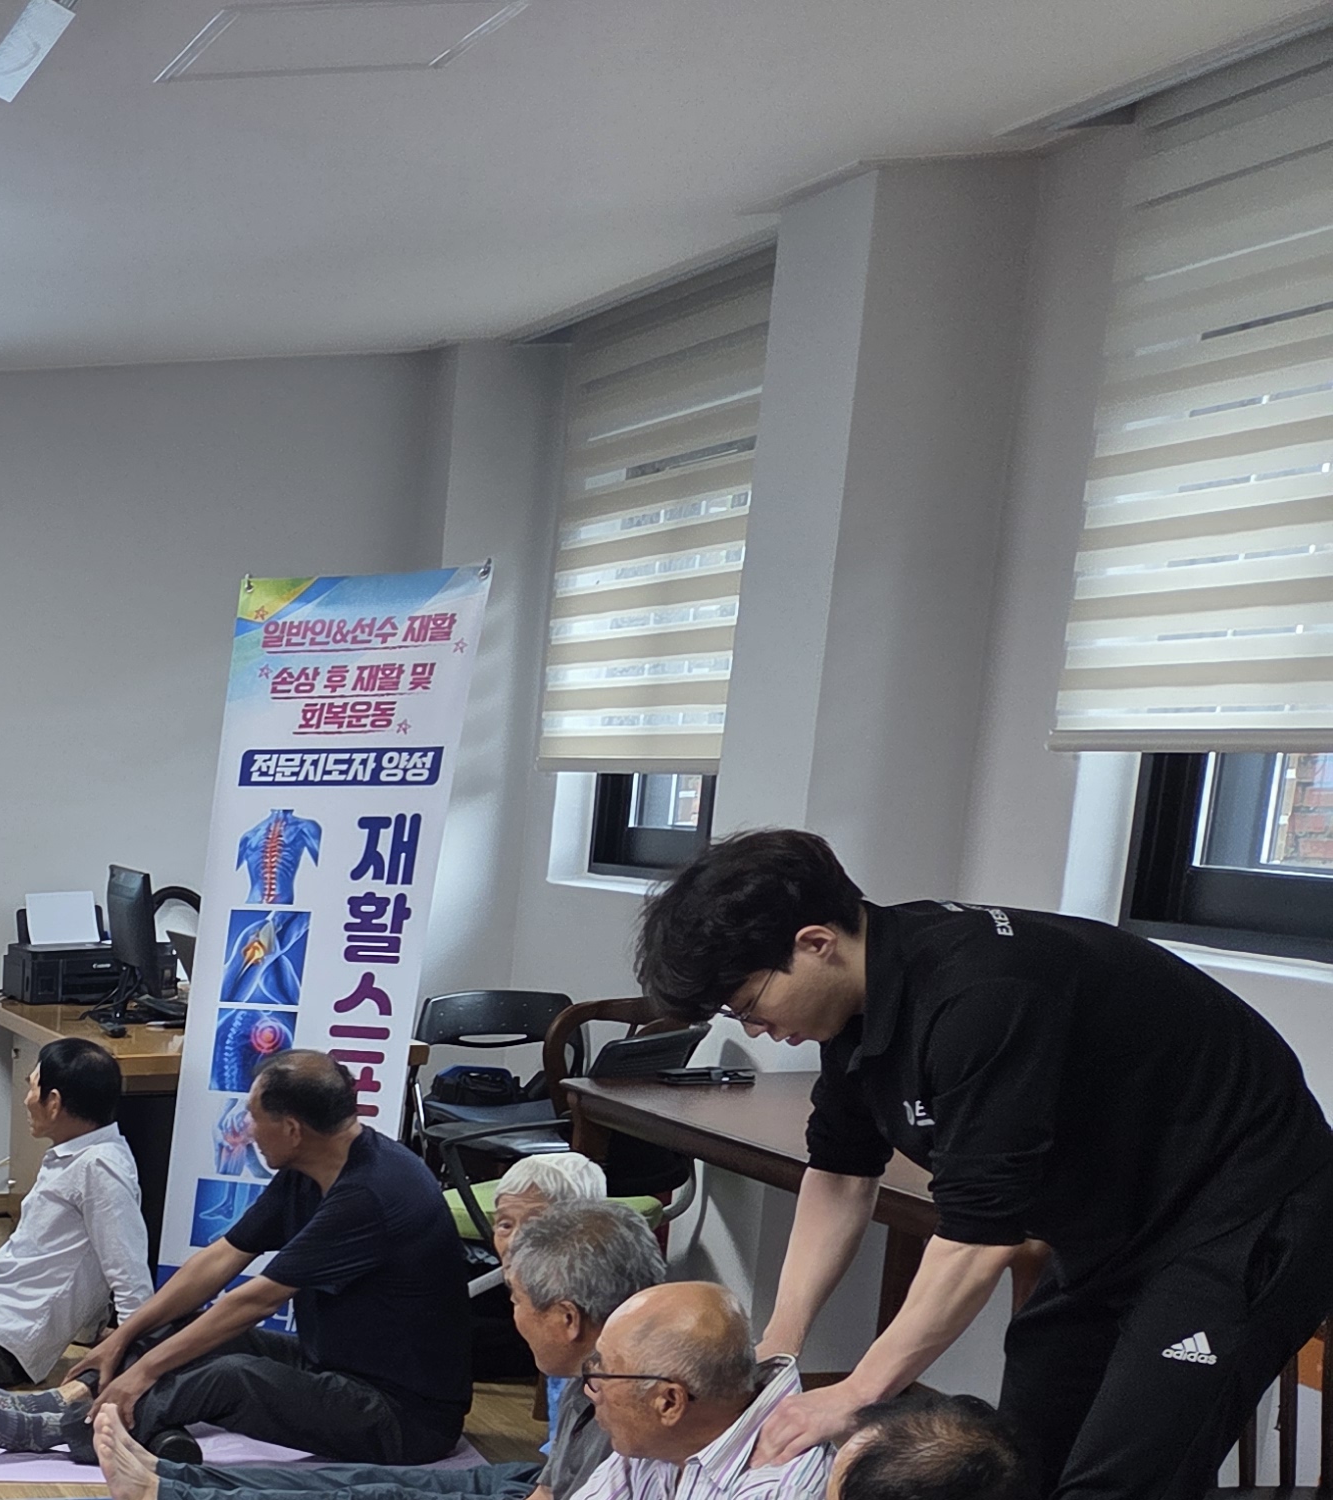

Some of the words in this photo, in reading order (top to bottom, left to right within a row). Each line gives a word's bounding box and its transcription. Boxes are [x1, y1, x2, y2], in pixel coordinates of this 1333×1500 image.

[262, 615, 399, 648] 일반인&선수
[402, 613, 457, 643] 재활
[270, 666, 320, 694] 손상
[323, 664, 350, 693] 후
[351, 662, 405, 692] 재활
[408, 662, 437, 690] 및
[298, 700, 397, 730] 회복운동
[250, 753, 377, 783] 전문지도자
[379, 751, 435, 782] 양성
[1161, 1348, 1218, 1366] adidas
